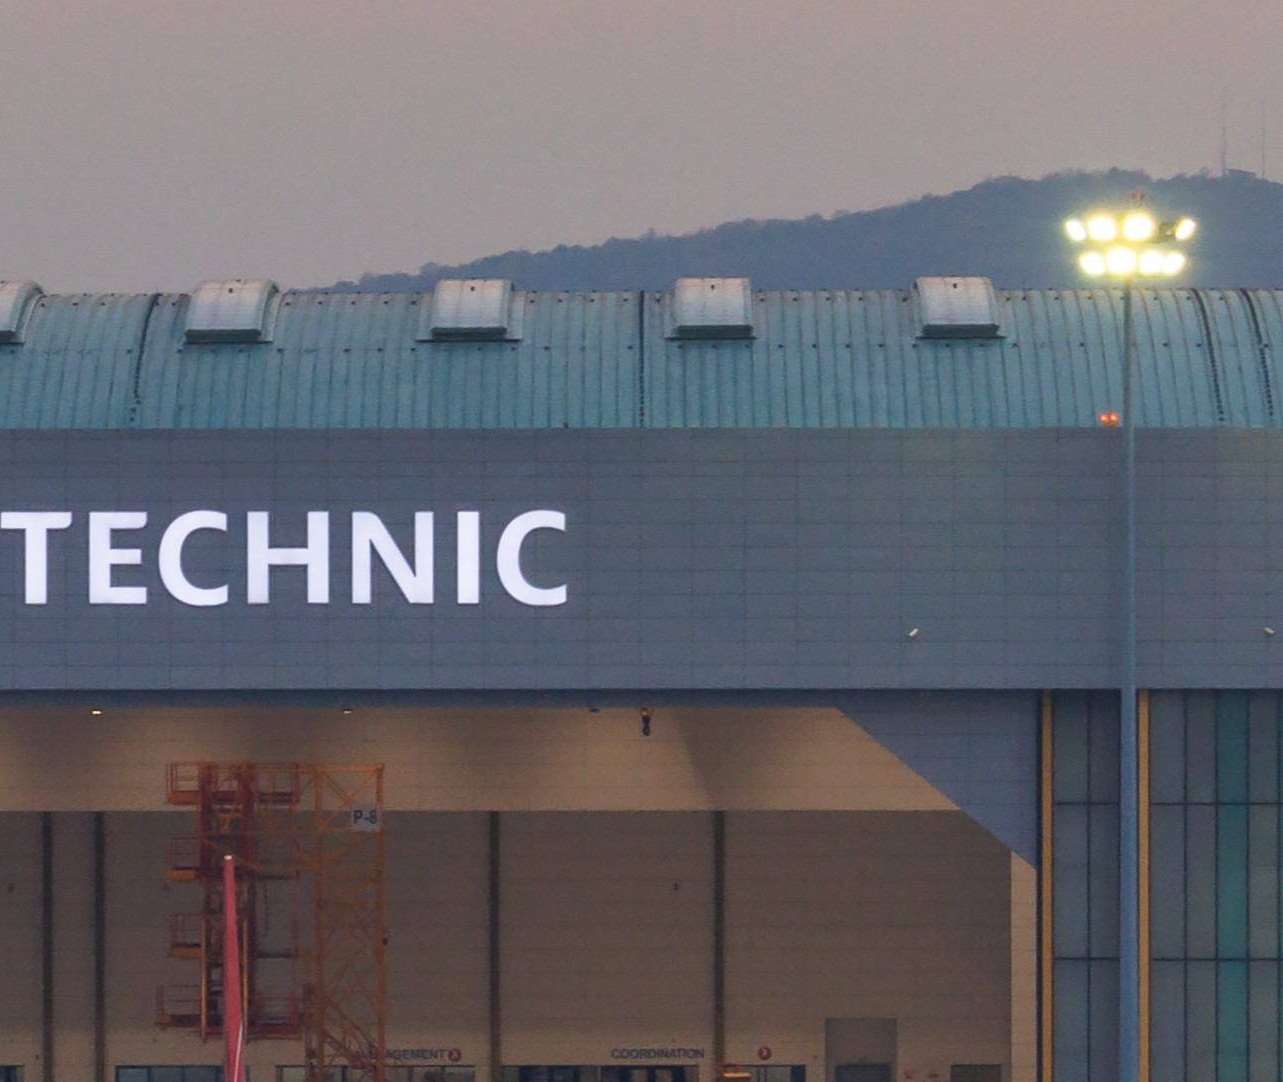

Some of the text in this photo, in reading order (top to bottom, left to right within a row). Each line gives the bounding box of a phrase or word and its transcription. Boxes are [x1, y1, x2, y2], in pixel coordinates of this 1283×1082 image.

[0, 510, 567, 606] TECHNIC
[353, 809, 378, 825] P-8
[611, 1048, 705, 1059] COORDINATION
